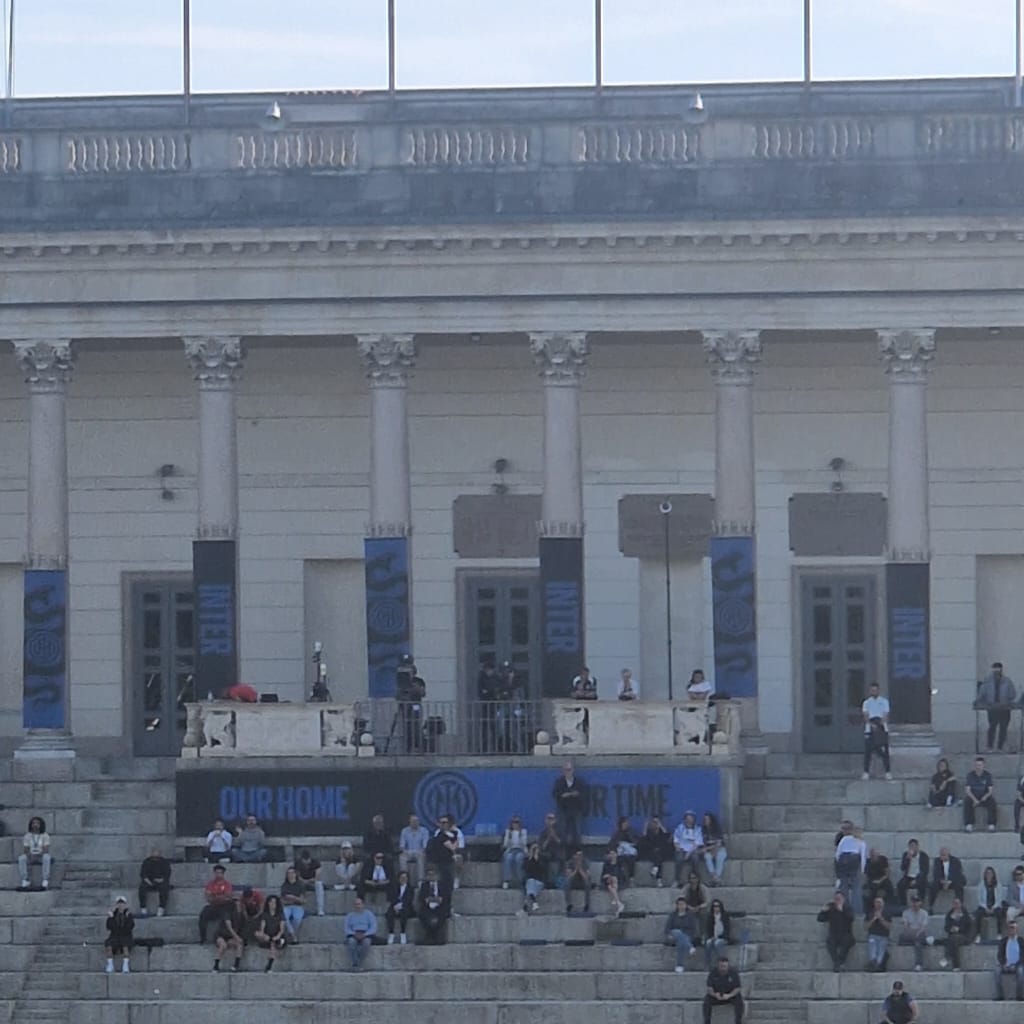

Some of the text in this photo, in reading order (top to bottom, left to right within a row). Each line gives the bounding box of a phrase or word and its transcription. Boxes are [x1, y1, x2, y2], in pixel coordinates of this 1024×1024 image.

[199, 584, 232, 656] INTER
[544, 581, 578, 652] INTER
[893, 607, 925, 677] INTER
[220, 785, 350, 819] OUR HOME
[612, 784, 672, 817] TIME
